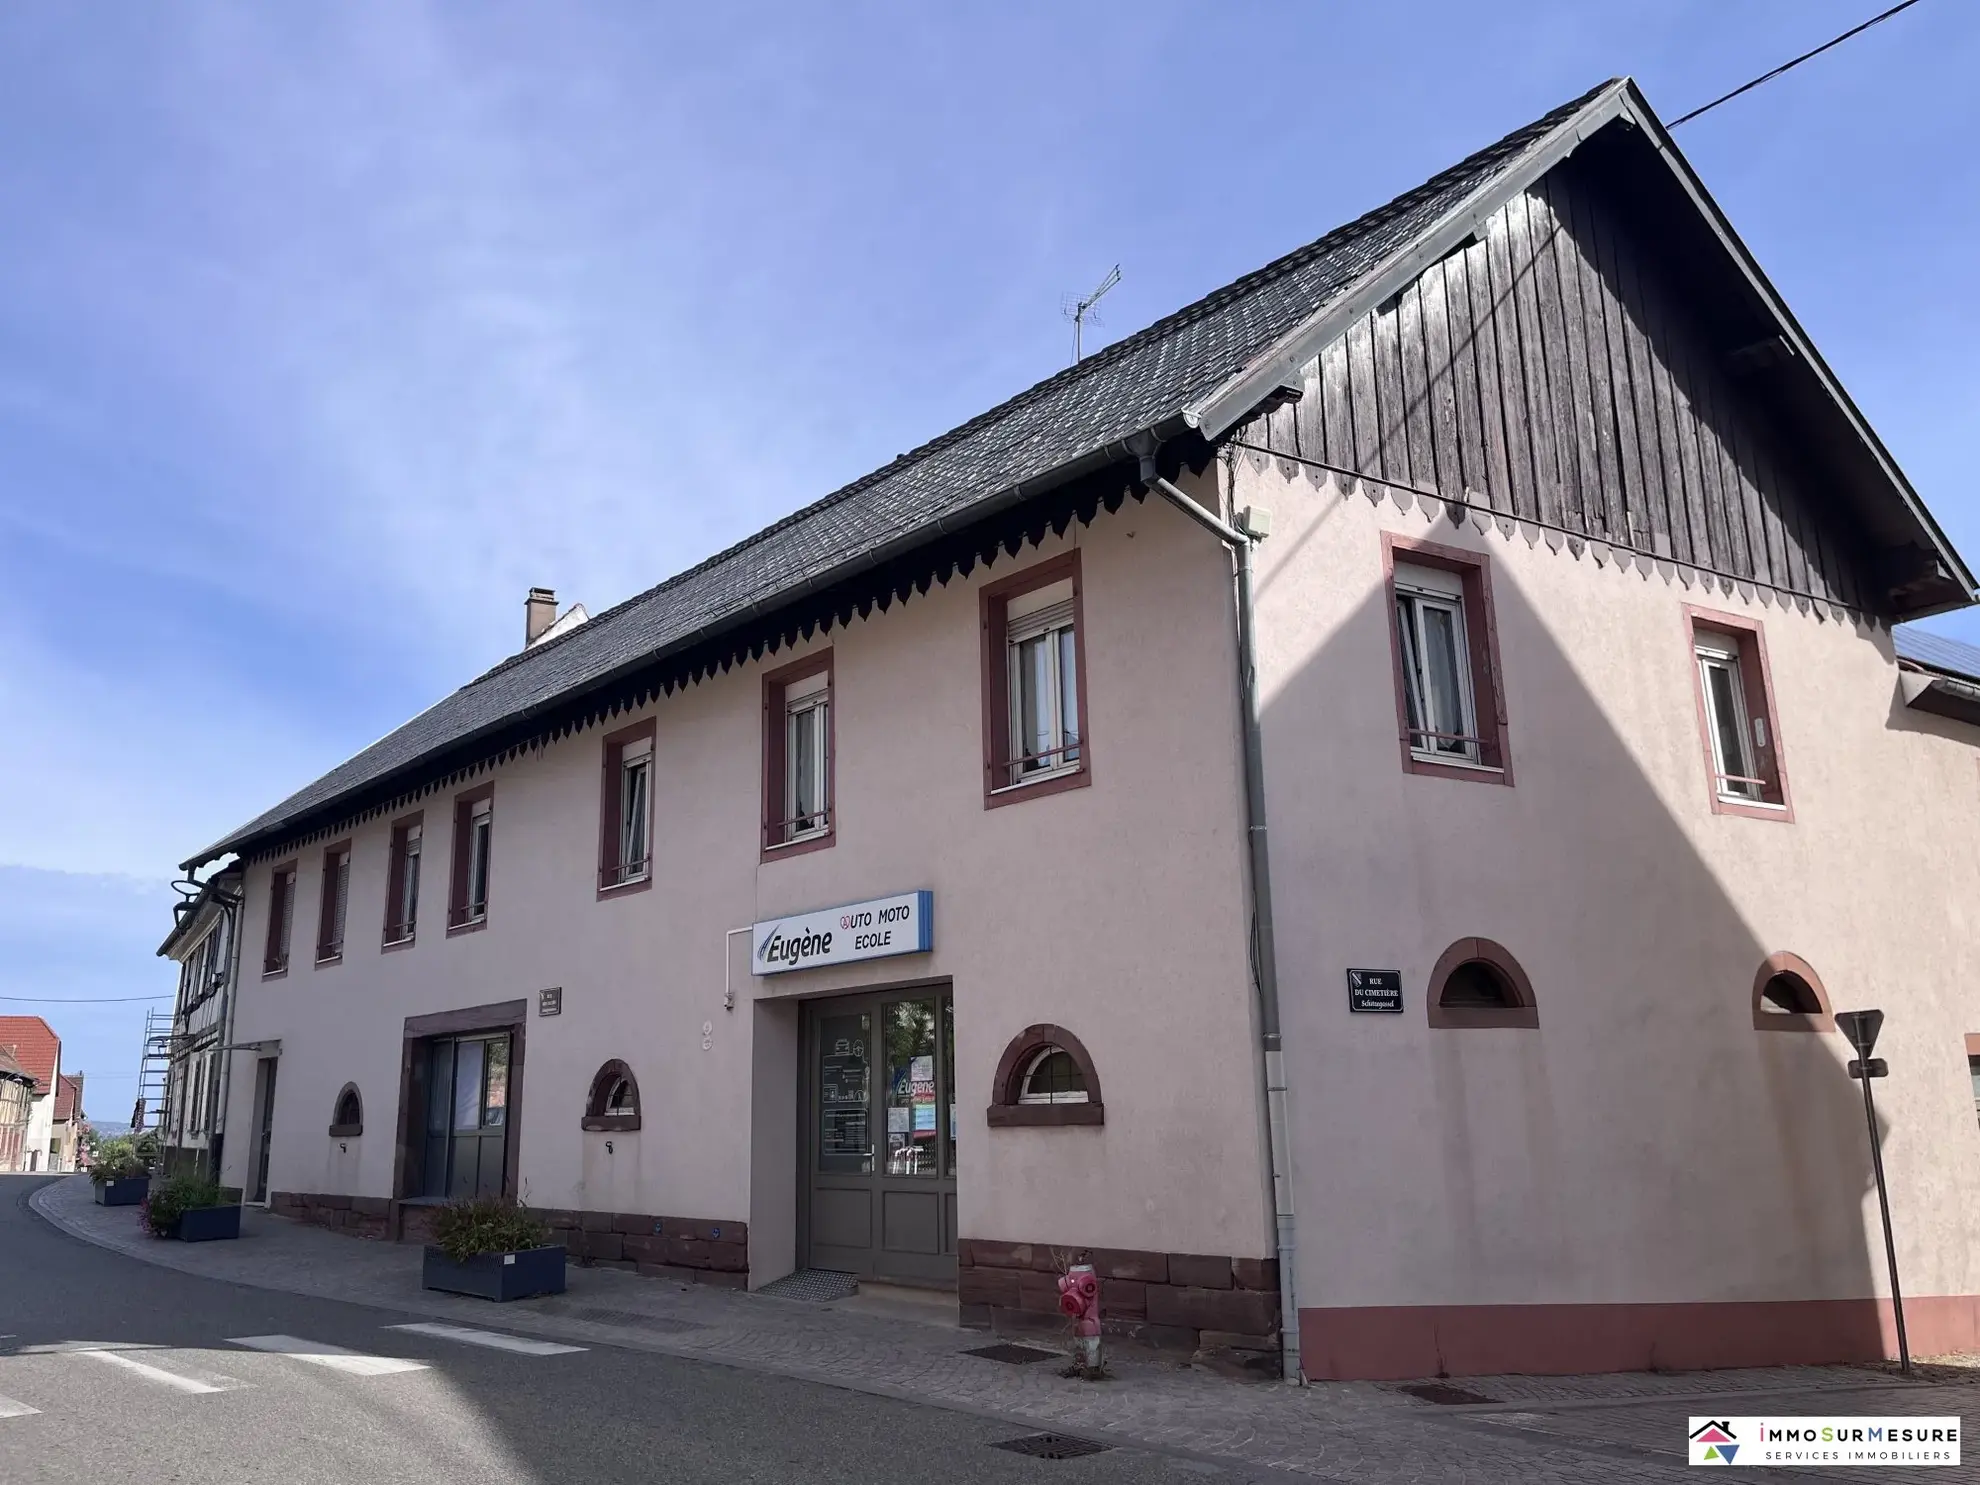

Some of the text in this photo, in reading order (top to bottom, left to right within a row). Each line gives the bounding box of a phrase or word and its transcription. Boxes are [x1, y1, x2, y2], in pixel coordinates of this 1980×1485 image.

[840, 905, 910, 930] AUTO MOTO
[767, 926, 832, 965] Eugène
[855, 930, 892, 949] ECOLE
[1369, 977, 1382, 985] RUE
[1365, 988, 1399, 997] CIMETIÈRE
